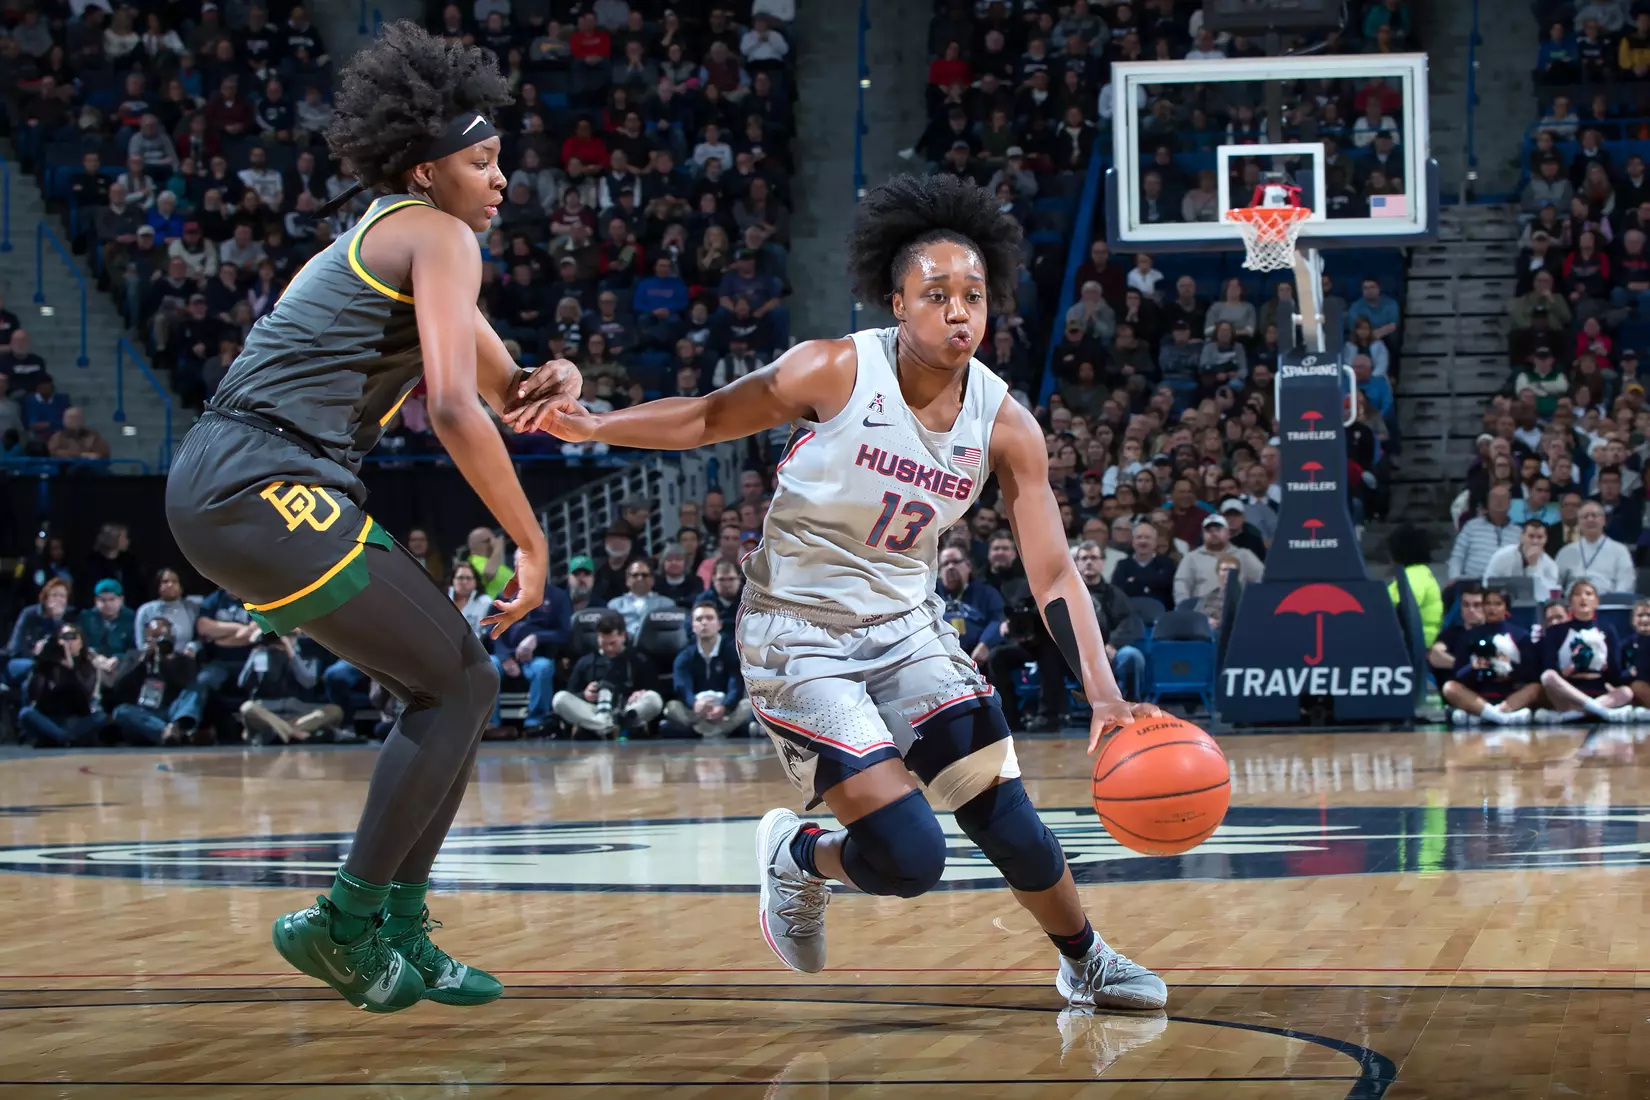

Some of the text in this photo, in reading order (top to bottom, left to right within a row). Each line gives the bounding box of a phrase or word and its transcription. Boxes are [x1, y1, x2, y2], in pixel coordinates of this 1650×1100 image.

[1282, 363, 1338, 378] SPALDING
[1287, 430, 1337, 441] TRAVELERS
[855, 443, 974, 501] HUSKIES
[1287, 480, 1337, 491] TRAVELERS
[865, 491, 936, 552] 13
[1288, 538, 1338, 549] TRAVELERS
[1222, 665, 1414, 697] TRAVELERS
[1136, 721, 1184, 737] UCONN
